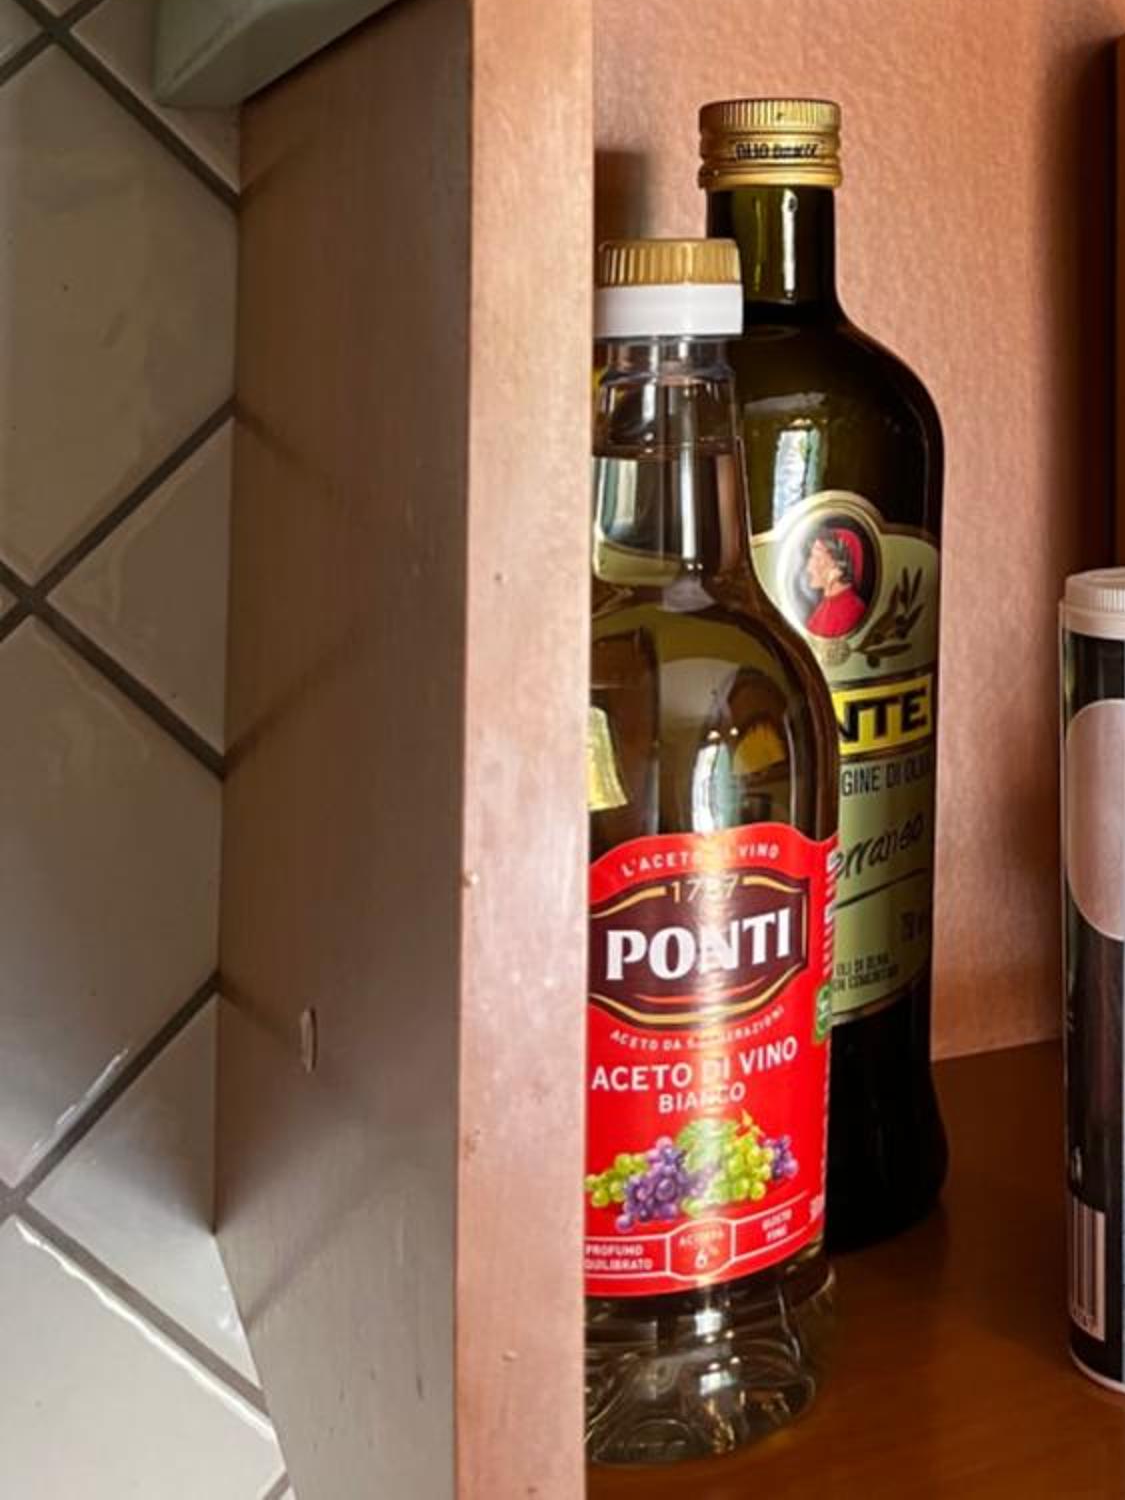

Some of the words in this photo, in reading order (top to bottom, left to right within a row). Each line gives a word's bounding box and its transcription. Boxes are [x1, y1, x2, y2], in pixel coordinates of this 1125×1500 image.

[738, 842, 781, 861] VINO
[605, 907, 792, 982] PONTI
[609, 1028, 660, 1052] ACETO
[590, 1061, 694, 1093] ACETO
[738, 1035, 798, 1076] VINO
